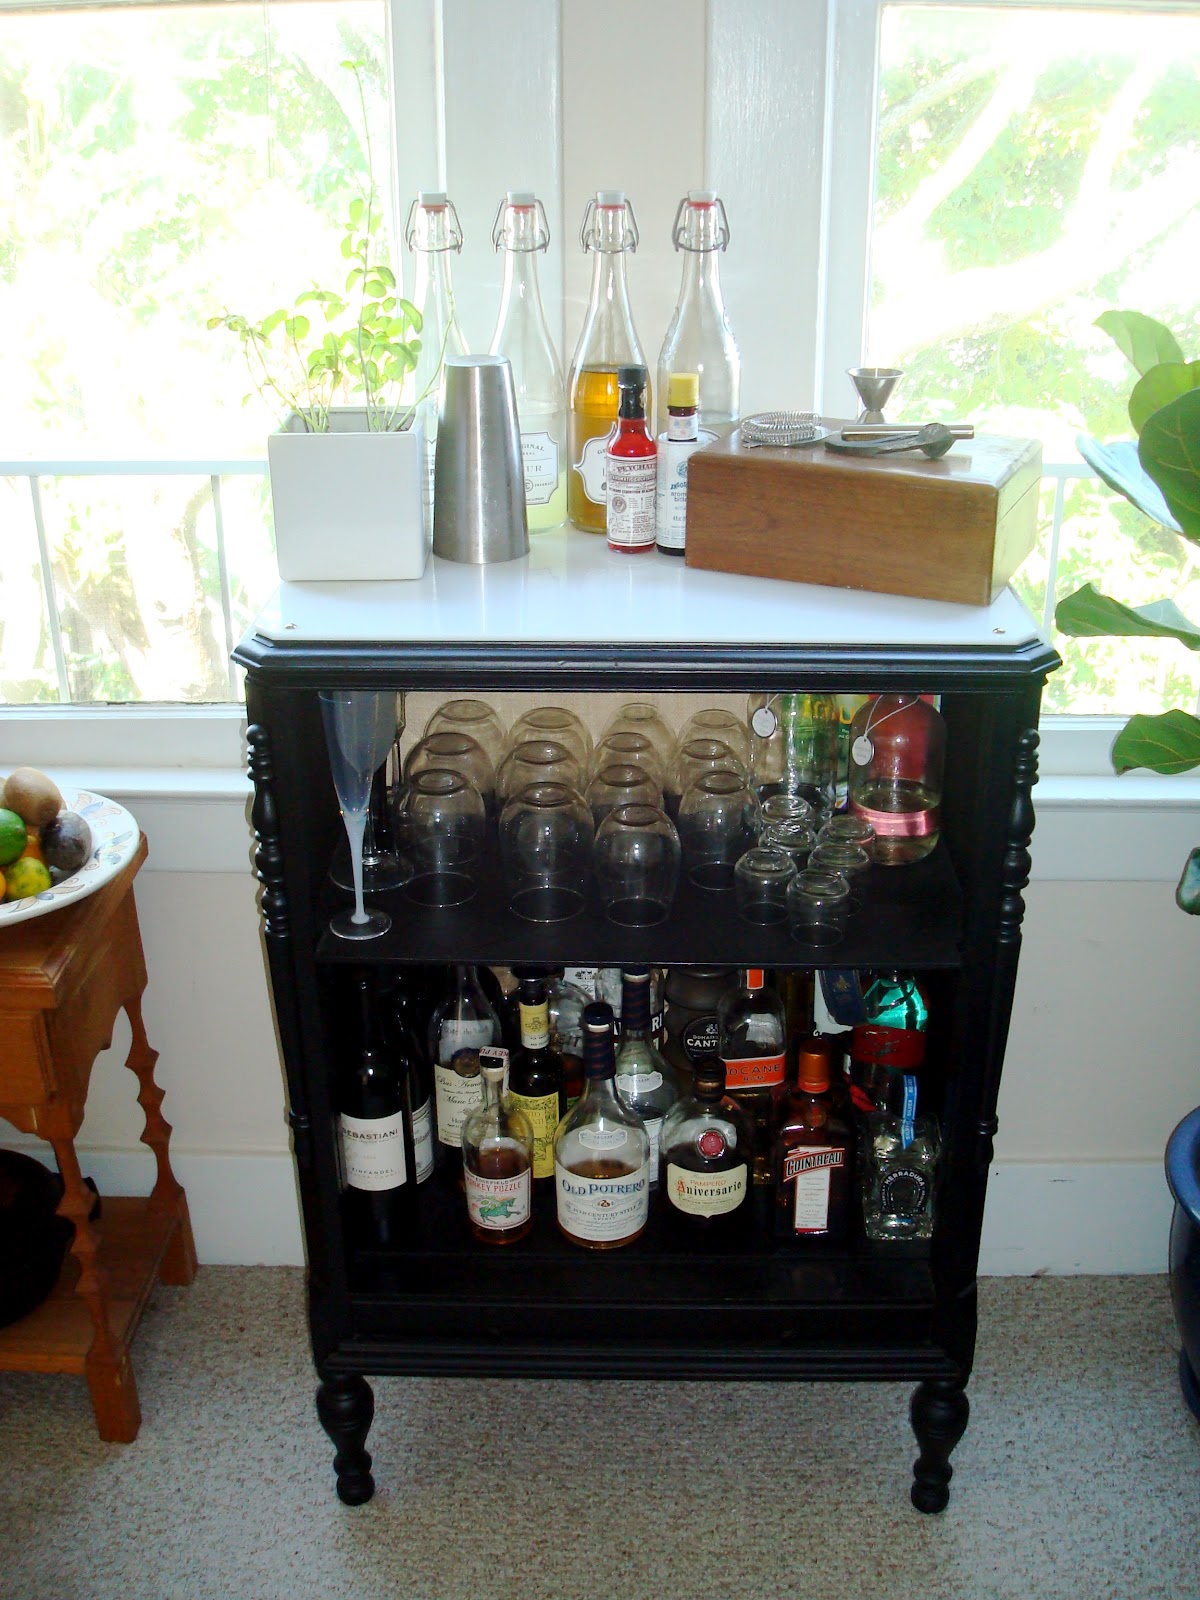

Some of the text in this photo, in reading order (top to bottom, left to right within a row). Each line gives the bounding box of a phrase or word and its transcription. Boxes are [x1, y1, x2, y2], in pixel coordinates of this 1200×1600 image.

[521, 443, 545, 452] GINAL
[686, 1038, 718, 1048] CANT
[343, 1127, 398, 1140] SEBASTIANI
[786, 1151, 843, 1178] COINTREAU
[689, 1179, 728, 1187] PAMPERO
[884, 1170, 926, 1187] HERRADURA
[493, 1181, 522, 1193] PUZZLE
[588, 1179, 646, 1196] POTRERO
[676, 1178, 742, 1197] Aniversario
[619, 1204, 638, 1215] STYLE
